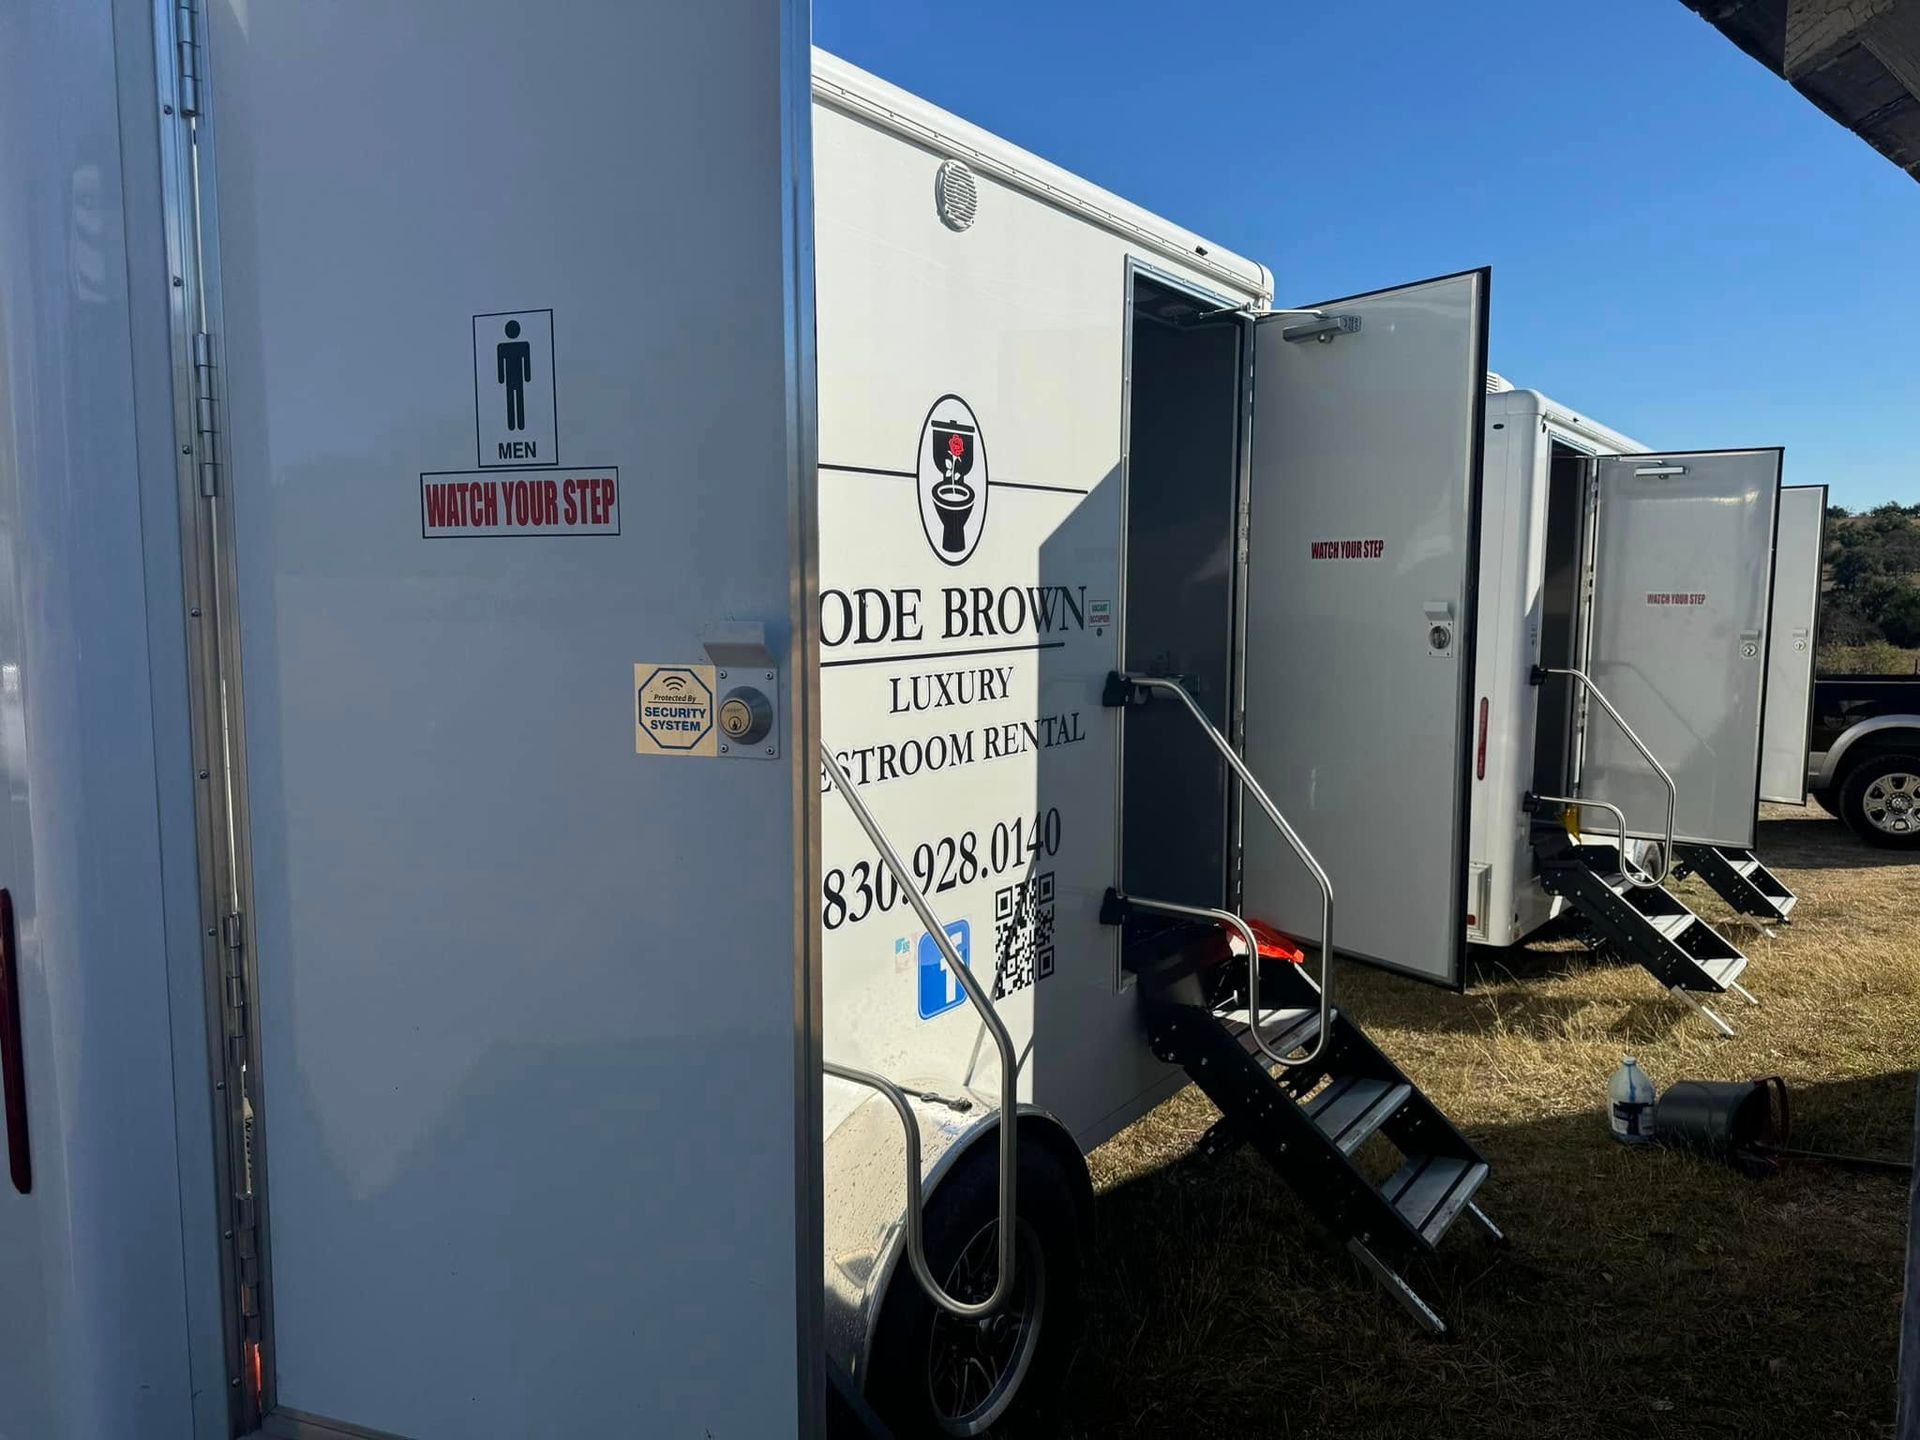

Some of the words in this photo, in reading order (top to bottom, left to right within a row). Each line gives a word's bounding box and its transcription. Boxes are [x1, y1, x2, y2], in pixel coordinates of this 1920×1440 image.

[498, 441, 537, 459] MEN
[425, 481, 498, 527] WATCH
[501, 479, 559, 526] YOUR
[562, 478, 616, 525] STEP
[1311, 541, 1339, 559] WATCH
[1341, 540, 1362, 559] YOUR
[1363, 539, 1384, 558] STEP
[1647, 593, 1670, 604] WATCH
[1671, 593, 1688, 605] YOUR
[1690, 593, 1706, 605] STEP
[819, 587, 923, 647] ODE
[941, 586, 1087, 639] BROWN
[653, 694, 686, 702] Protected
[687, 695, 697, 704] By
[889, 666, 1014, 714] LUXURY
[644, 707, 706, 719] SECURITY
[650, 720, 701, 731] SYSTEM
[983, 712, 1085, 760] RENTAL
[823, 807, 1061, 931] 830.928.0140
